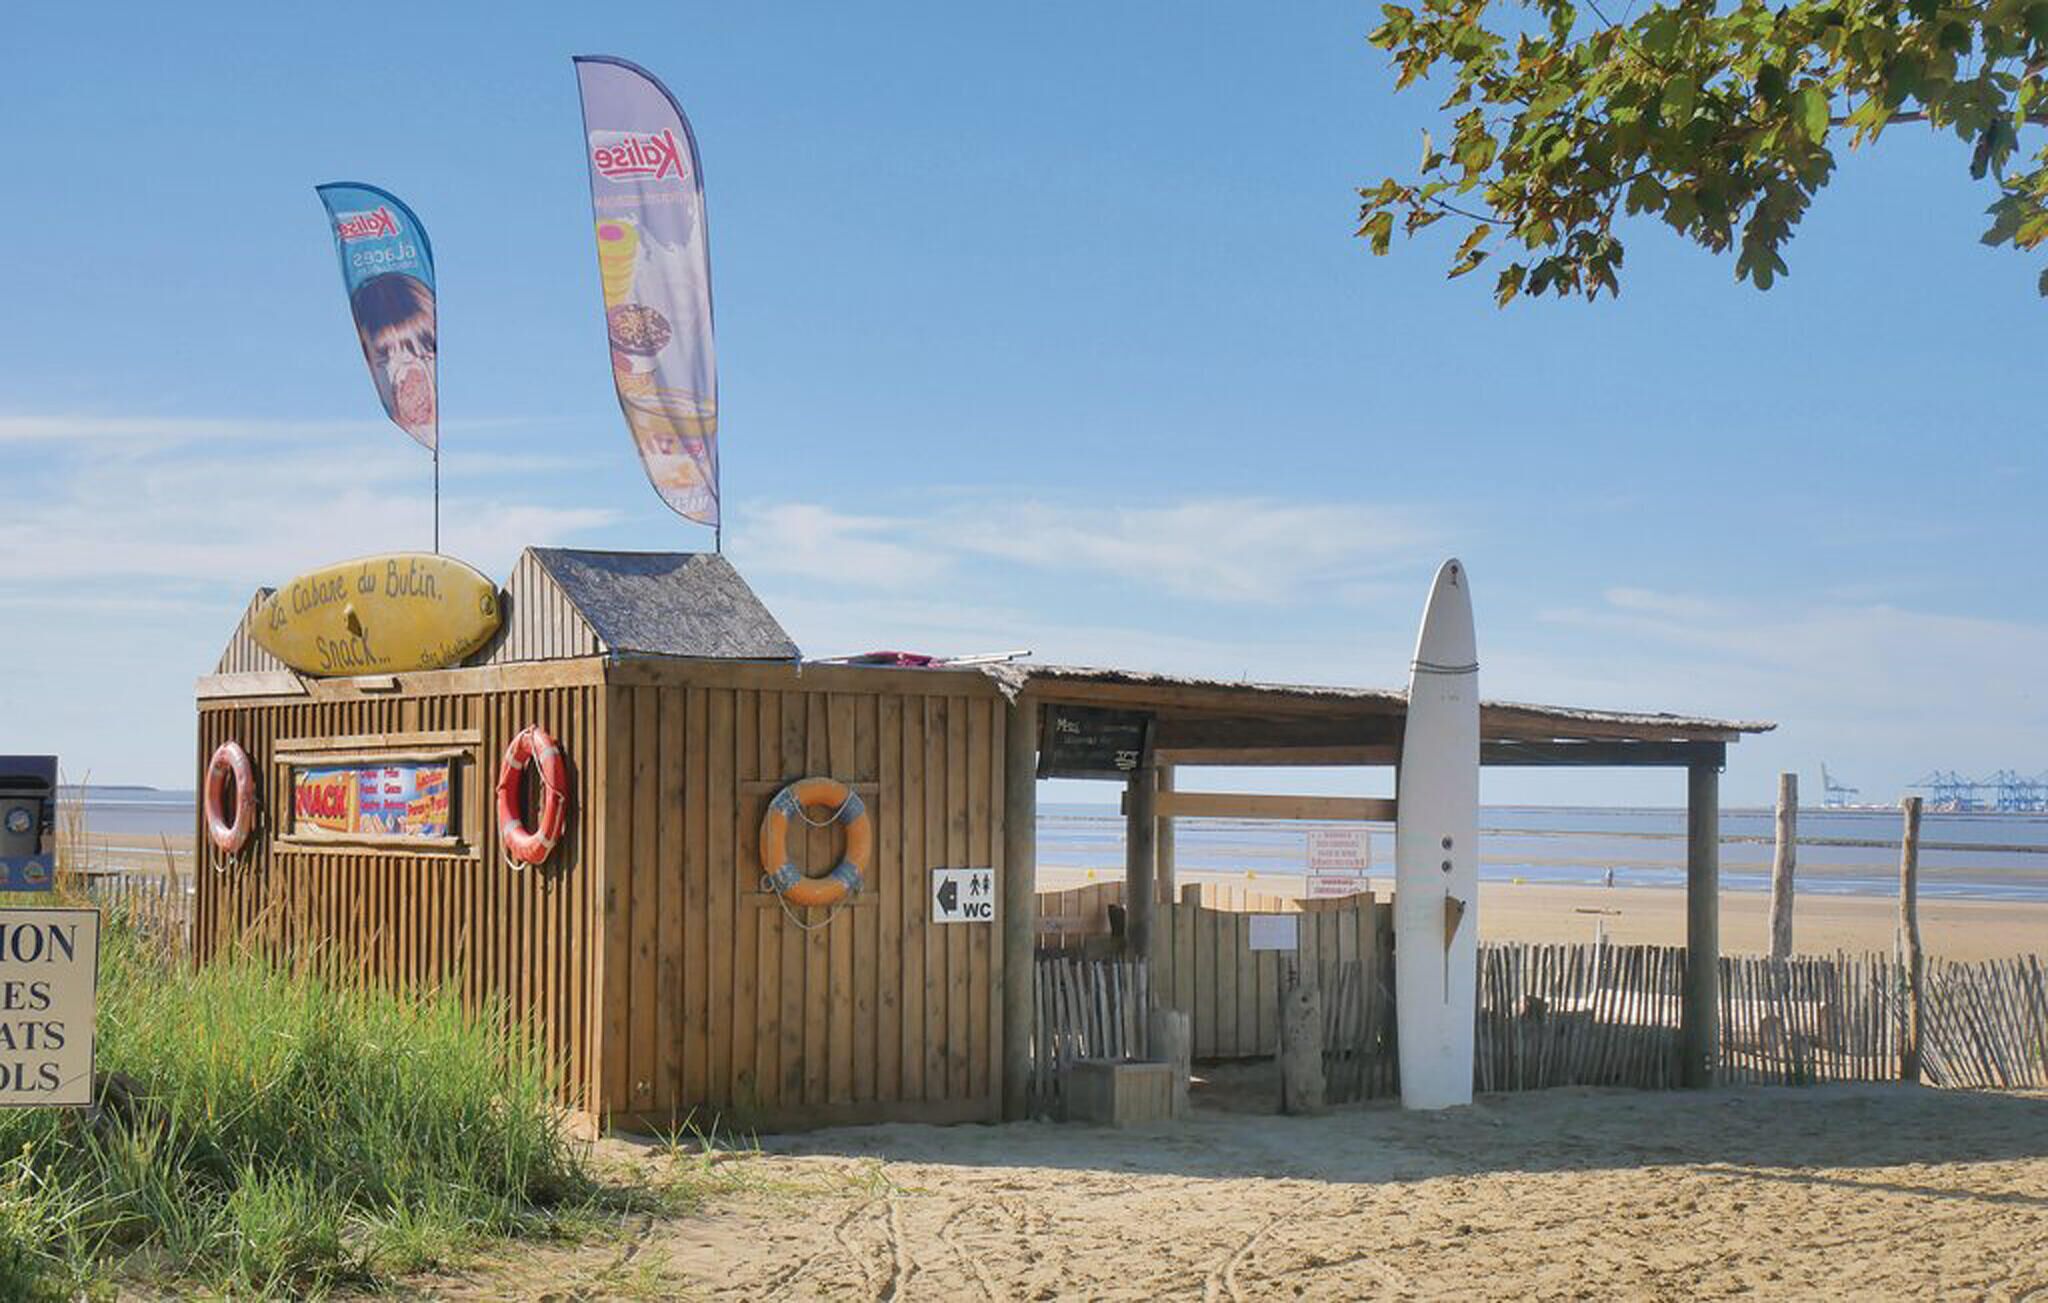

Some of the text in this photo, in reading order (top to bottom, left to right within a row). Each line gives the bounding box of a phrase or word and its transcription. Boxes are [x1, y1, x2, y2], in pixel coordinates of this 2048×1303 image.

[358, 562, 376, 595] du
[963, 902, 991, 918] WC
[4, 981, 51, 1011] ES
